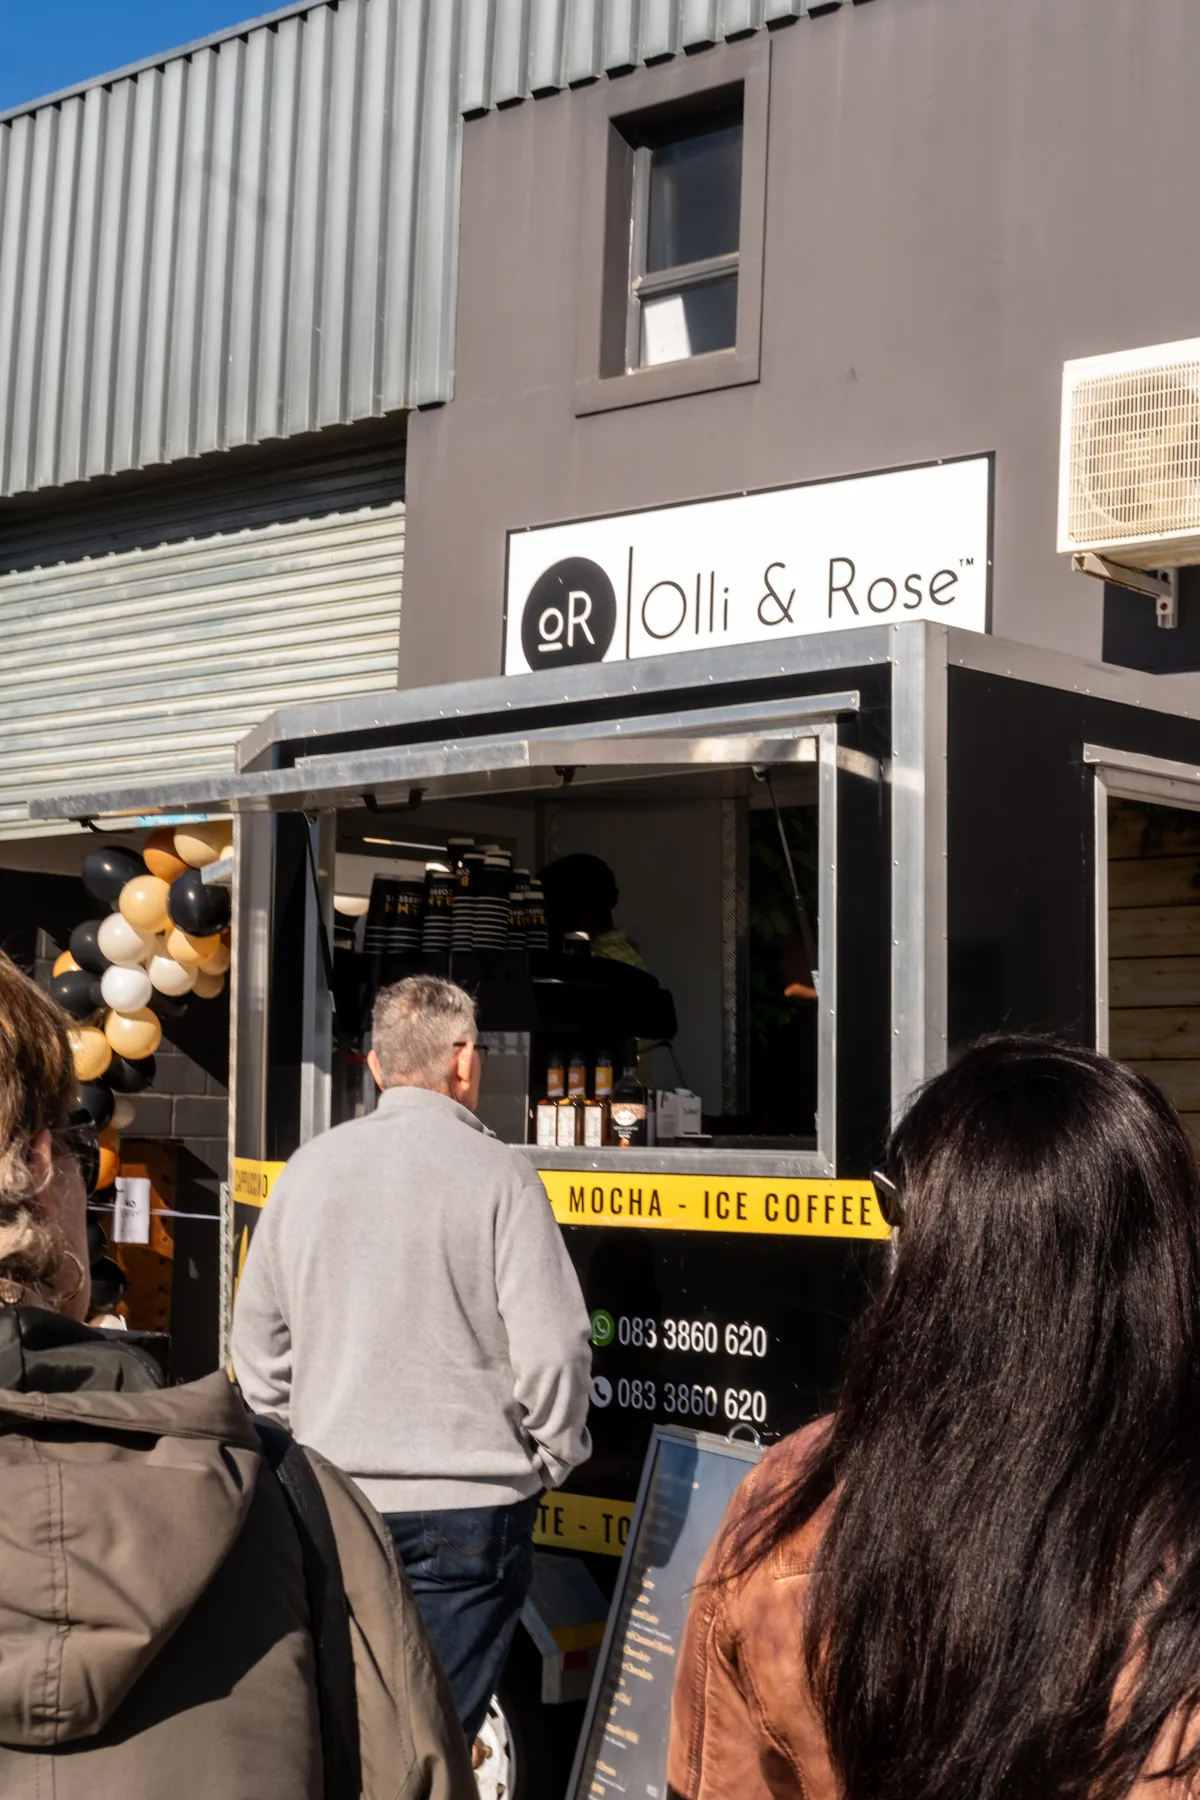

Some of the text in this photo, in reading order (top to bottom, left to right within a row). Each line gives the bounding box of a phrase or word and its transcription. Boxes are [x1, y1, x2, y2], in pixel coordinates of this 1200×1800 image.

[642, 570, 730, 640] Olli
[756, 561, 797, 627] &
[828, 556, 960, 619] Rose
[569, 1186, 662, 1217] MOCHA
[704, 1190, 748, 1221] ICE
[764, 1193, 872, 1226] COFFEE
[618, 1316, 767, 1358] 083 3860 620
[617, 1378, 767, 1423] 083 3860 620
[532, 1505, 565, 1537] TE
